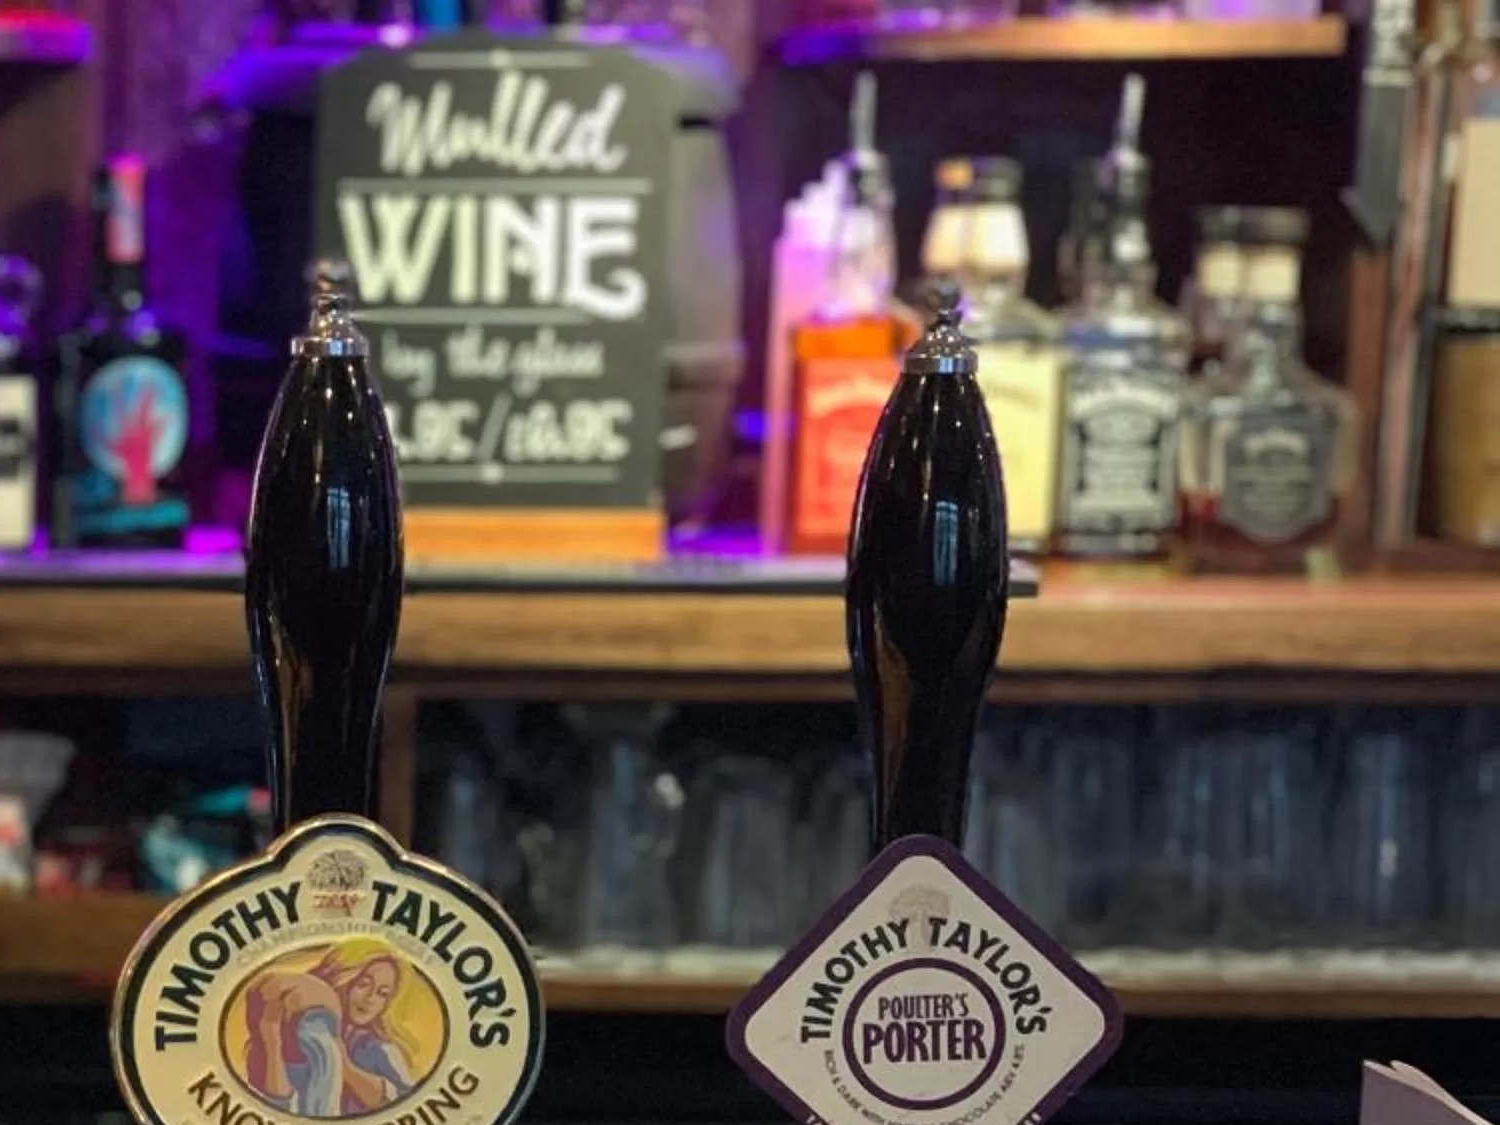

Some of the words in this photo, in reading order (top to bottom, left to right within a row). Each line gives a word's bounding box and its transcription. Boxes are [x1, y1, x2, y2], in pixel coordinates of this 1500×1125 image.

[366, 68, 627, 176] Mulled
[336, 194, 647, 319] WINE
[381, 328, 436, 397] by
[155, 881, 301, 1052] TIMOTHY
[371, 880, 517, 1049] TAYLOR'S
[801, 917, 910, 1044] TIMOTHY
[927, 917, 1053, 1036] TAYLOR'S
[878, 992, 970, 1019] POULTER'S
[863, 1018, 987, 1065] PORTER
